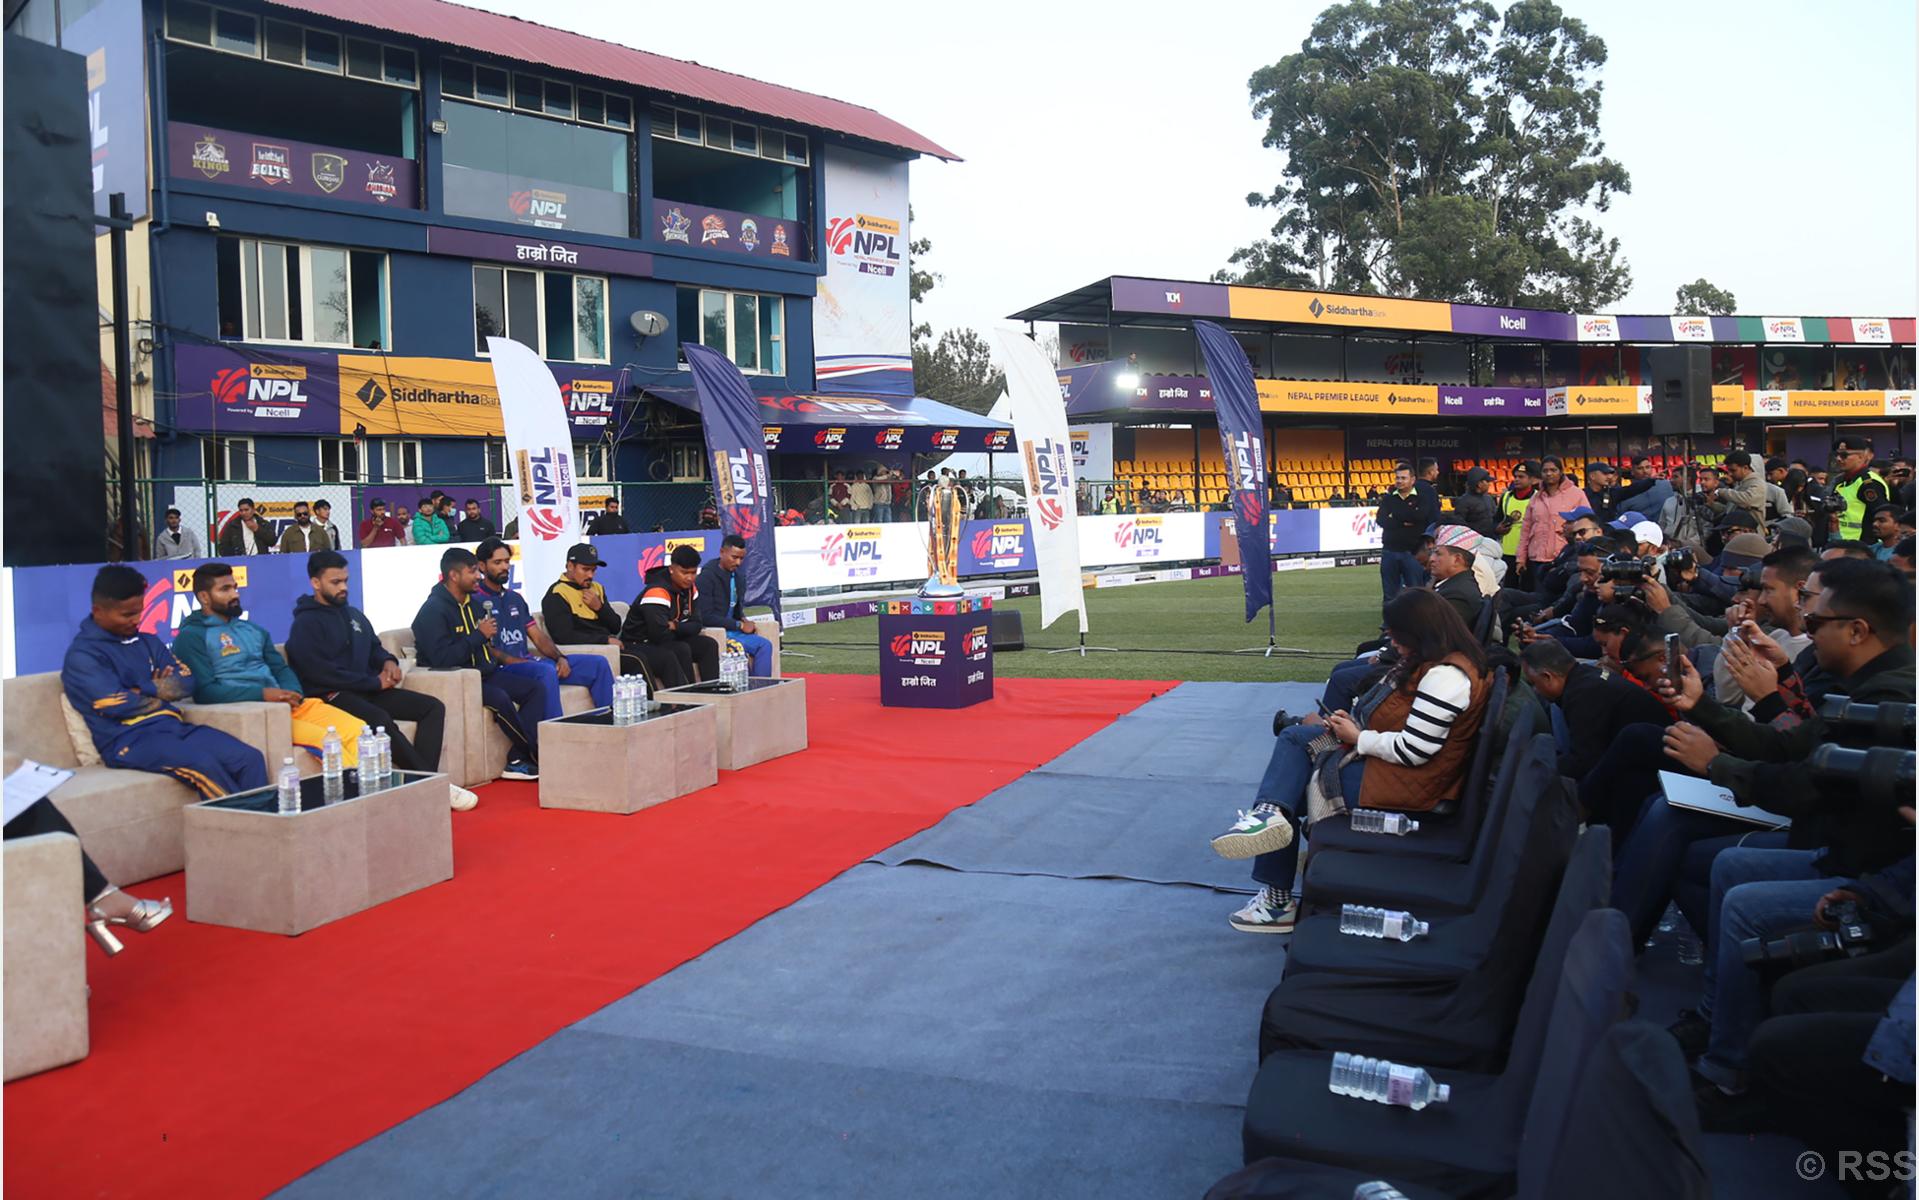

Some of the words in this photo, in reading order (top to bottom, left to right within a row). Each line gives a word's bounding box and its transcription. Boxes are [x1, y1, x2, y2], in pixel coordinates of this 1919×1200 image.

[252, 163, 290, 179] BOLTS
[530, 199, 567, 219] NPL
[854, 230, 900, 260] NPL
[515, 244, 548, 261] हाम्रो
[549, 245, 579, 265] जित
[867, 263, 887, 275] Ncell
[1326, 304, 1374, 318] Siddhartha
[1500, 315, 1526, 331] Ncell
[248, 379, 308, 402] NPL
[391, 387, 481, 406] Siddhartha
[1288, 391, 1313, 400] NEPAL
[1315, 392, 1349, 402] PREMIER
[1350, 393, 1379, 402] LEAGUE
[570, 392, 613, 412] NPL
[1445, 395, 1463, 406] Ncell
[1524, 398, 1541, 407] Ncell
[1793, 399, 1817, 407] NEPAL
[266, 408, 290, 416] Ncell
[824, 432, 844, 444] NPL
[884, 432, 902, 444] NPL
[940, 434, 957, 445] NPL
[992, 435, 1008, 445] NPL
[1035, 438, 1058, 495] NPL
[1235, 431, 1256, 490] NPL
[530, 447, 557, 505] NPL
[560, 464, 570, 487] Ncell
[729, 448, 754, 504] NPL
[756, 463, 766, 487] Ncell
[1133, 528, 1163, 545] NPL
[844, 540, 882, 562] NPL
[991, 537, 1024, 555] NPL
[1199, 568, 1212, 576] Ncell
[828, 610, 845, 621] Ncell
[910, 640, 946, 655] NPL
[971, 634, 988, 651] NPL
